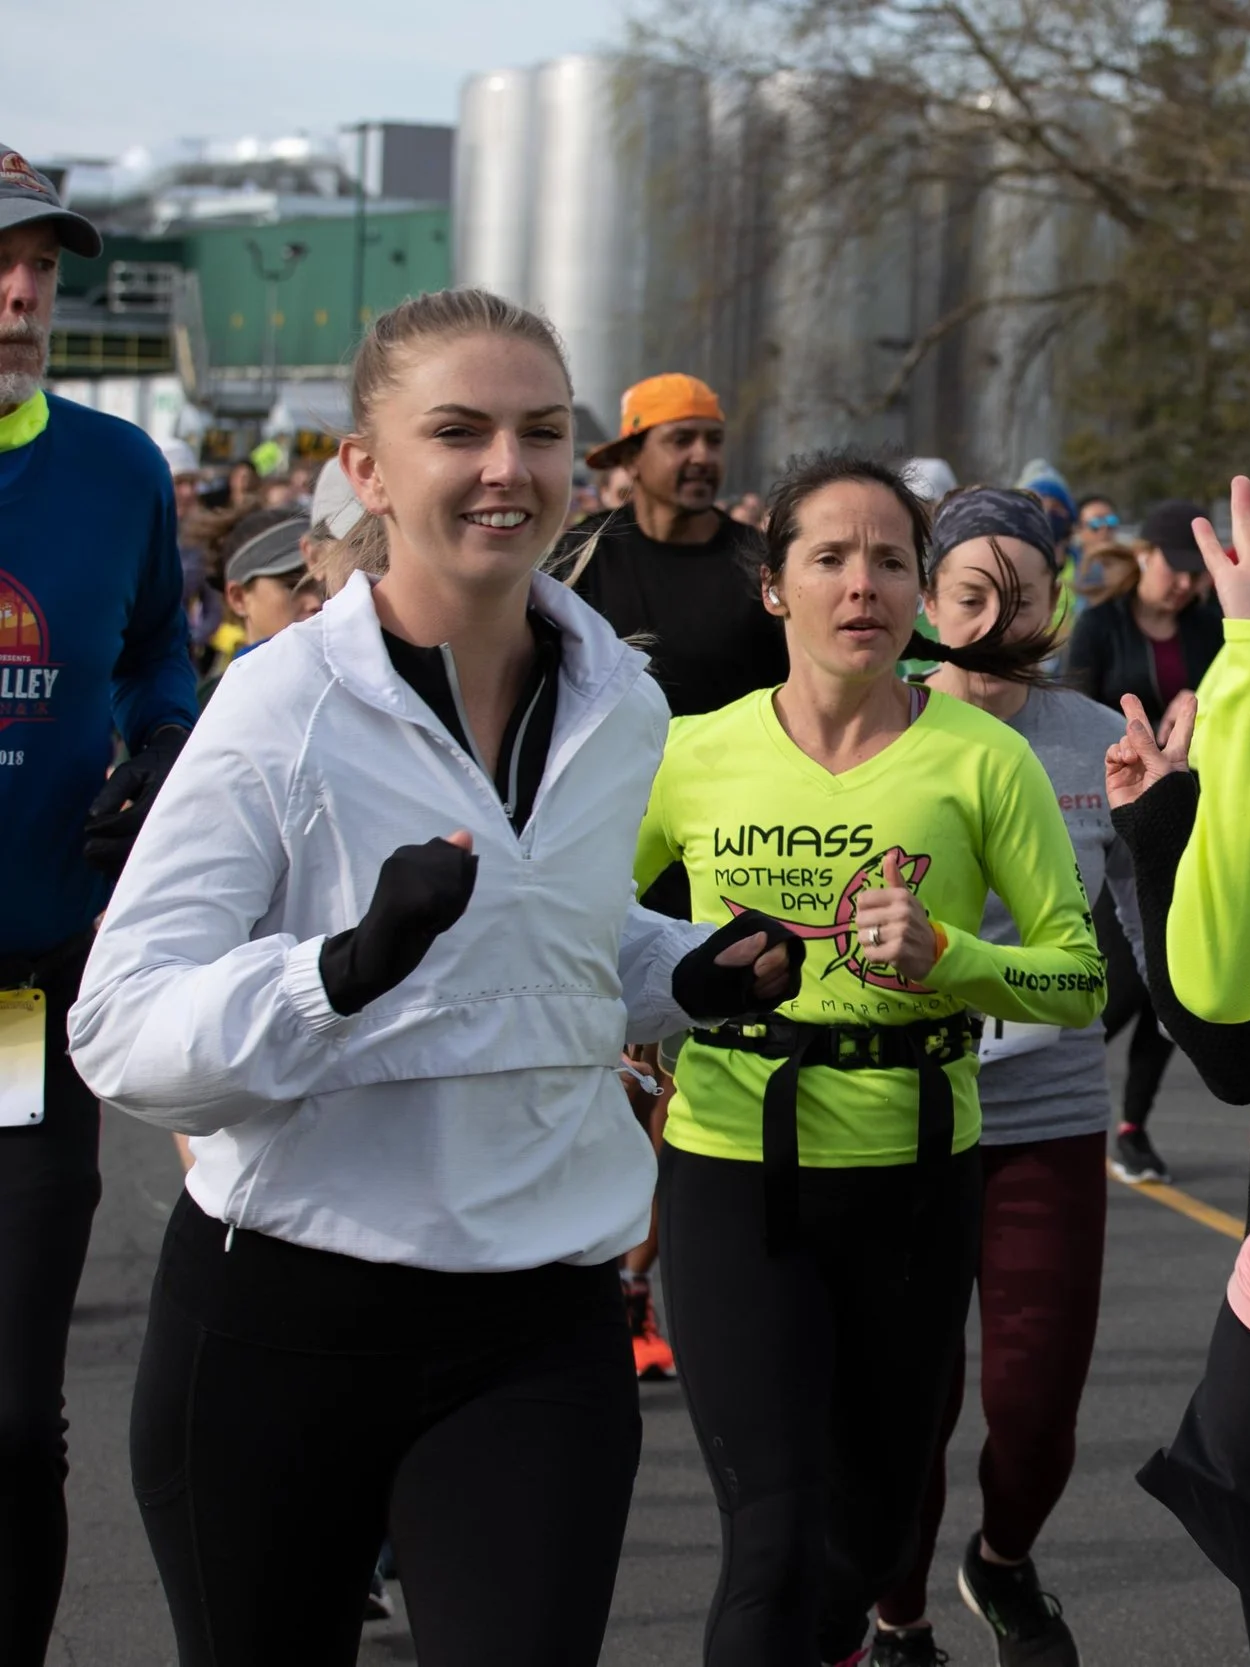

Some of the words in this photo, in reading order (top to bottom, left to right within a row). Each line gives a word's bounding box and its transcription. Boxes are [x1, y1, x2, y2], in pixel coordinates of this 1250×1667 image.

[714, 824, 873, 857] WMASS
[715, 868, 833, 887] MOTHER'S
[781, 893, 834, 910] DAY
